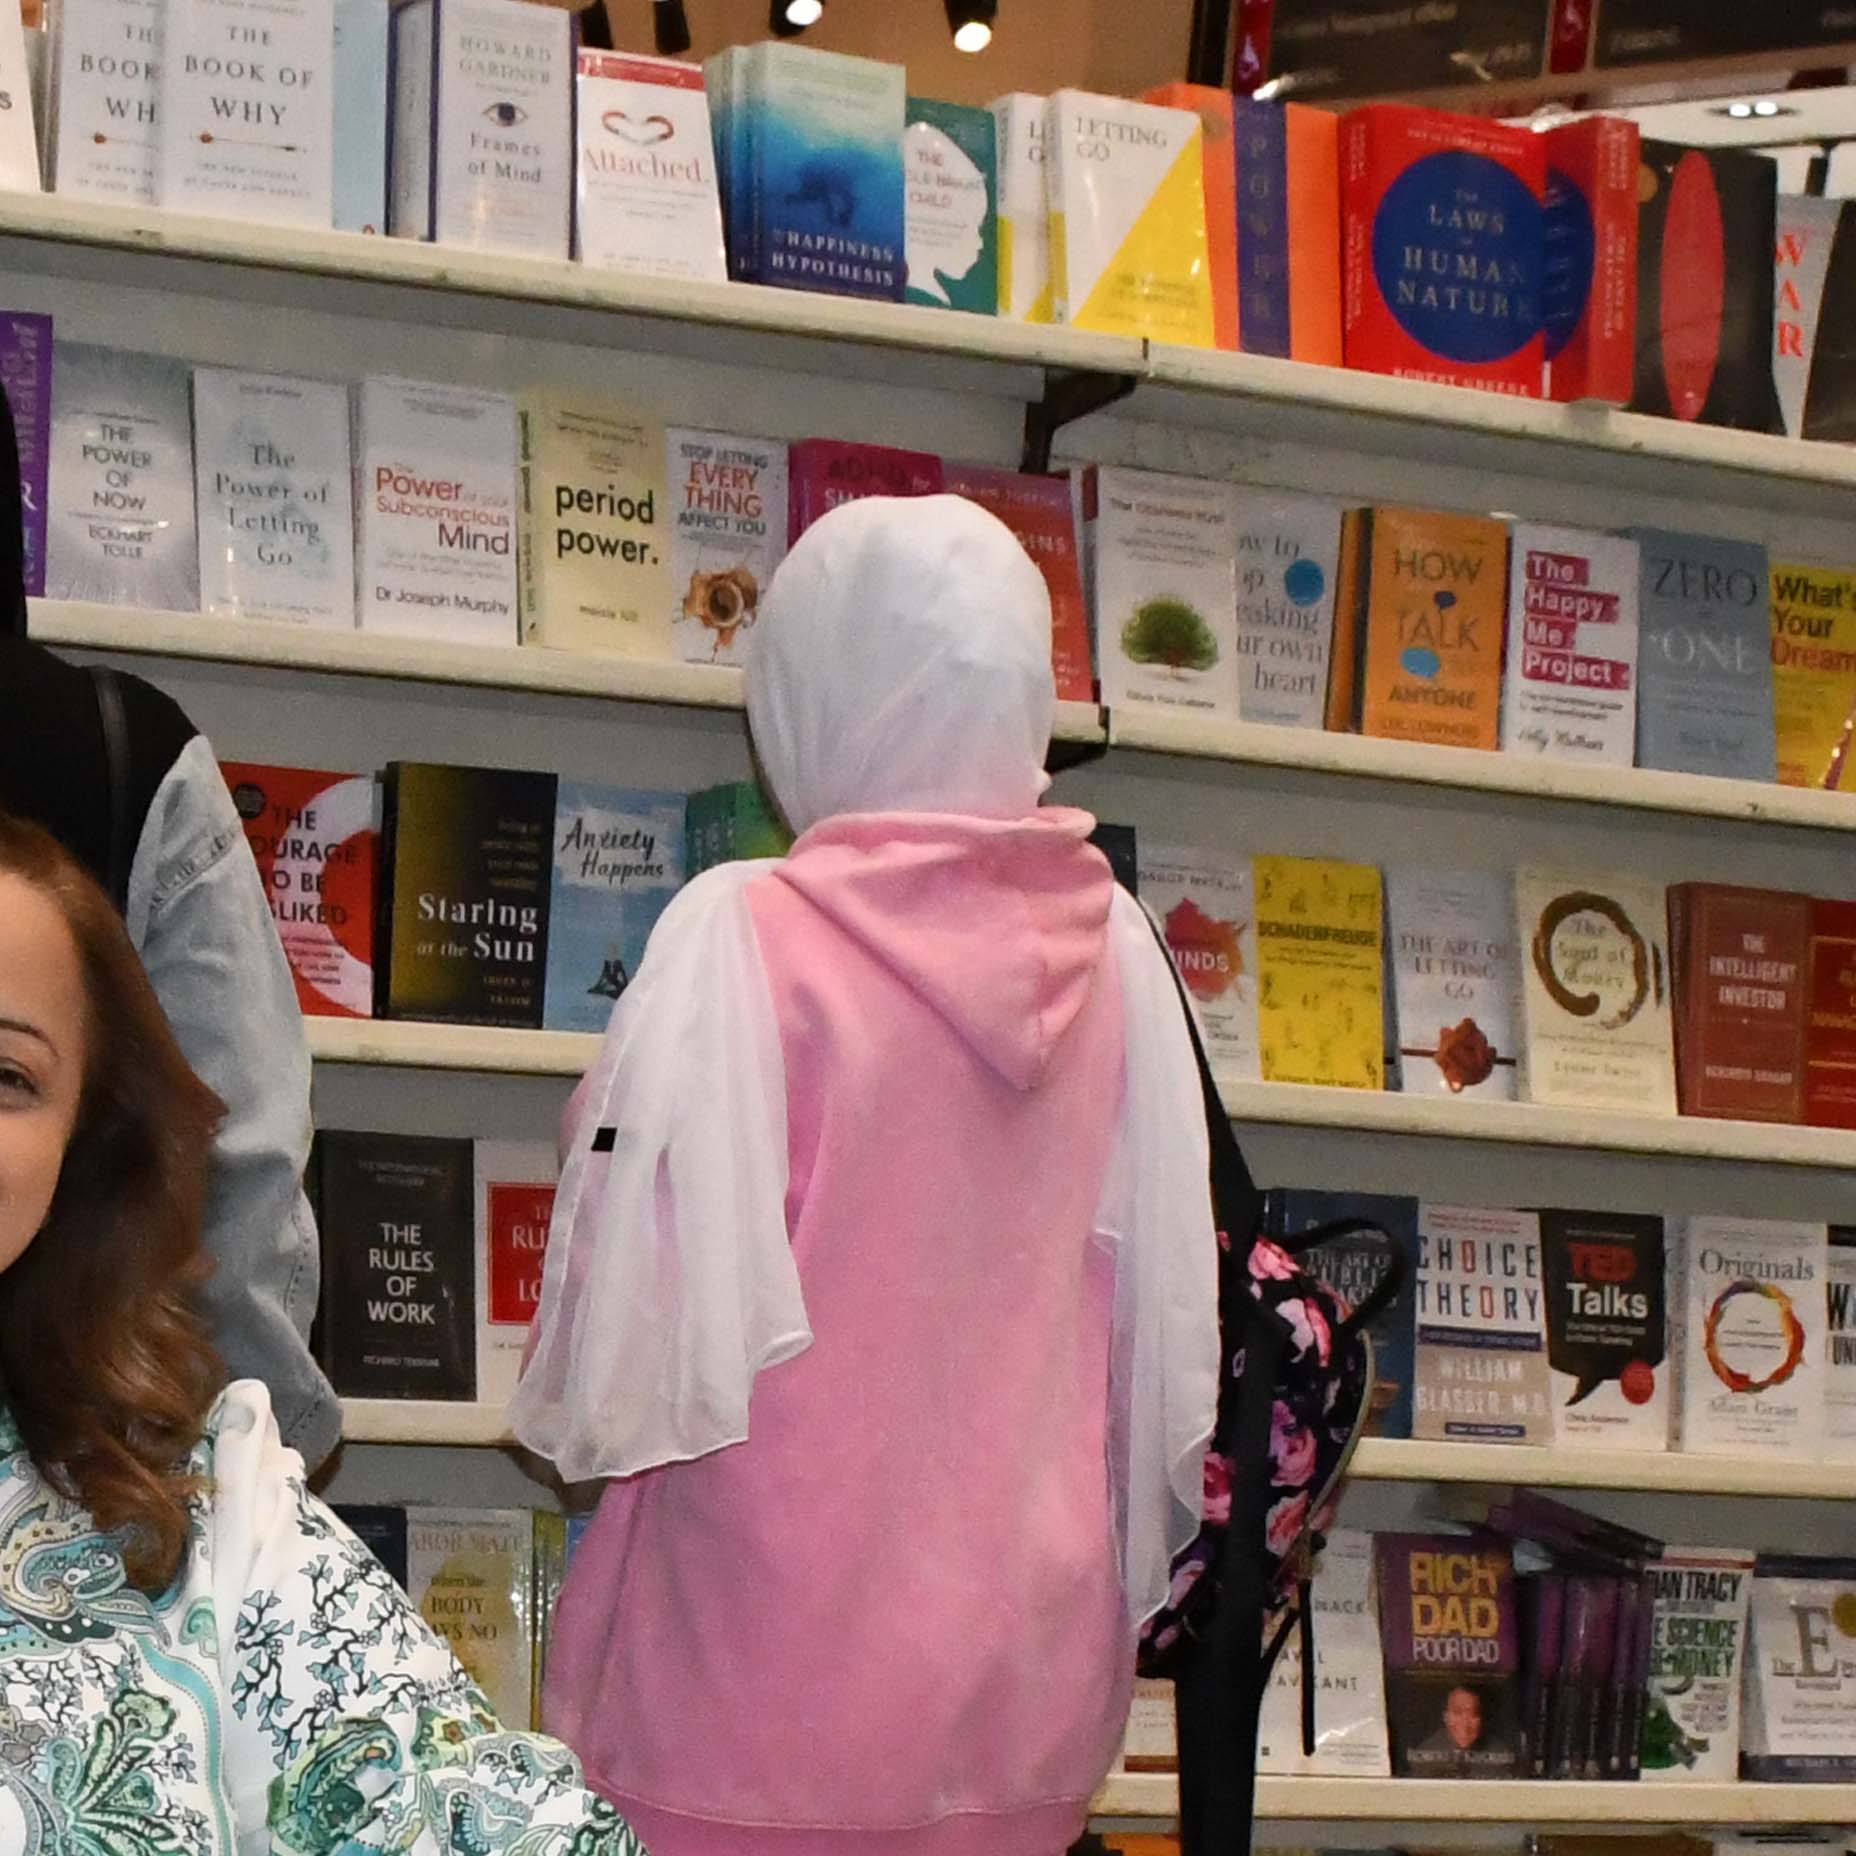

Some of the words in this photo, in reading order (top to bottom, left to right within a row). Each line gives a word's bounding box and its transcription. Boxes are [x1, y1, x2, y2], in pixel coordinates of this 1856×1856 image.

[185, 56, 264, 83] BOOK
[279, 68, 314, 87] OF
[210, 96, 288, 127] WHY
[470, 133, 542, 158] Frames
[468, 159, 489, 178] of
[495, 162, 542, 185] Mind
[788, 230, 894, 263] HAPPINESS
[771, 252, 894, 287] HYPOTHESIS
[82, 444, 152, 467] POWER
[249, 443, 296, 468] The
[375, 467, 463, 500] Power
[689, 461, 758, 493] EVERY
[93, 490, 147, 511] NOW
[375, 499, 510, 528] Subconscious
[555, 482, 656, 526] period
[684, 486, 762, 519] THING
[678, 512, 731, 534] AFFECT
[735, 515, 766, 535] YOU
[436, 525, 510, 556] Mind
[556, 525, 659, 564] power.
[1391, 549, 1484, 585] HOW
[1531, 557, 1576, 582] The
[1651, 557, 1759, 608] ZERO
[1528, 587, 1604, 622] Happy
[1394, 608, 1480, 652] TALK
[1527, 619, 1562, 647] Me
[1771, 608, 1834, 640] Your
[1525, 650, 1612, 686] Project
[560, 817, 656, 854] Anxiety
[579, 850, 664, 884] Happens
[381, 1221, 422, 1245] THE
[368, 1247, 435, 1273] RULES
[1417, 1233, 1538, 1280] CHOICE
[1566, 1243, 1638, 1283] TED
[1698, 1247, 1815, 1282] Originals
[386, 1275, 417, 1297] OF
[1416, 1279, 1540, 1323] THEORY
[1564, 1282, 1649, 1320] Talks
[366, 1299, 436, 1325] WORK
[1409, 1551, 1500, 1595] RICH
[1686, 1573, 1742, 1602] TRACY
[1411, 1600, 1500, 1637] DAD
[1411, 1637, 1458, 1662] POOR
[1460, 1639, 1500, 1664] DAD
